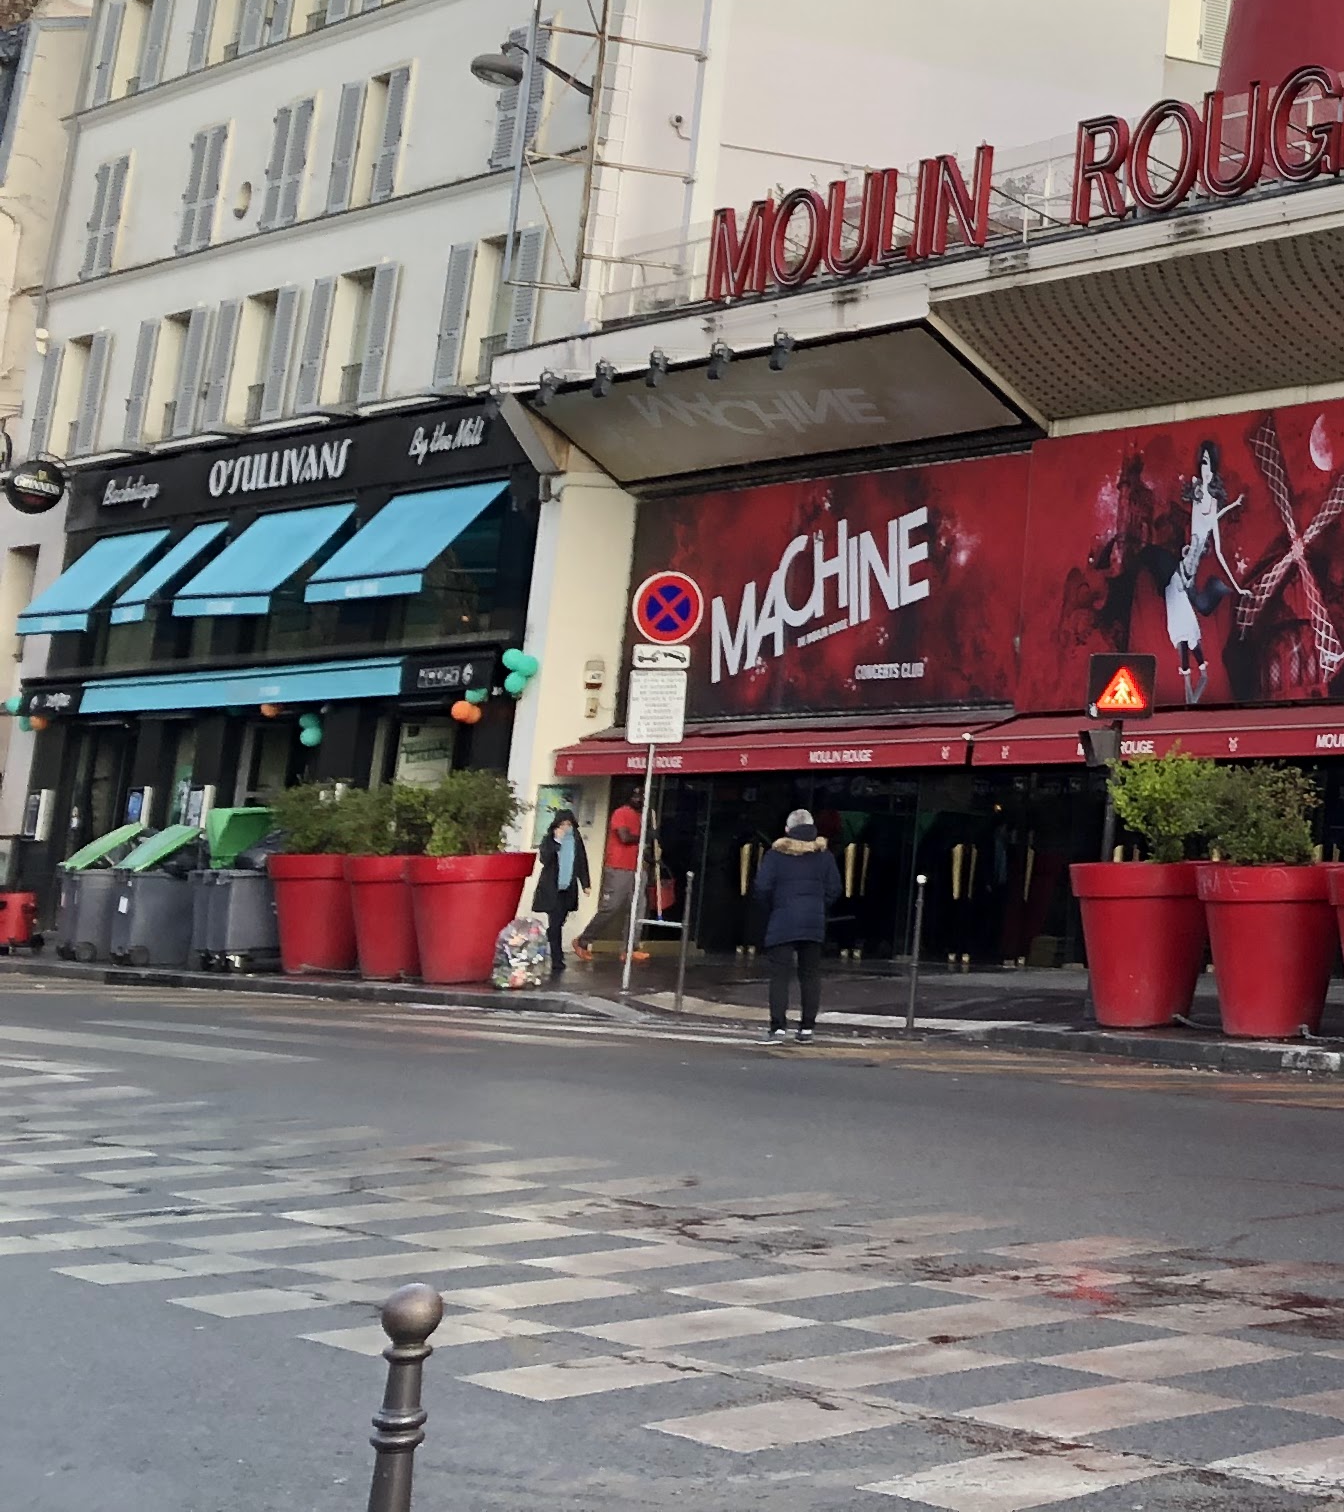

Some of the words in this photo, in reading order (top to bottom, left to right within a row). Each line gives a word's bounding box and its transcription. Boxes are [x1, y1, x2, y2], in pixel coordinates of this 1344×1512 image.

[706, 141, 994, 302] MOULIN
[209, 439, 352, 498] O'SULLIVANS
[408, 426, 429, 465] By
[711, 506, 931, 684] MACHINE
[900, 662, 924, 678] CLUB
[809, 751, 843, 764] MOULIN
[844, 749, 874, 763] ROUGE
